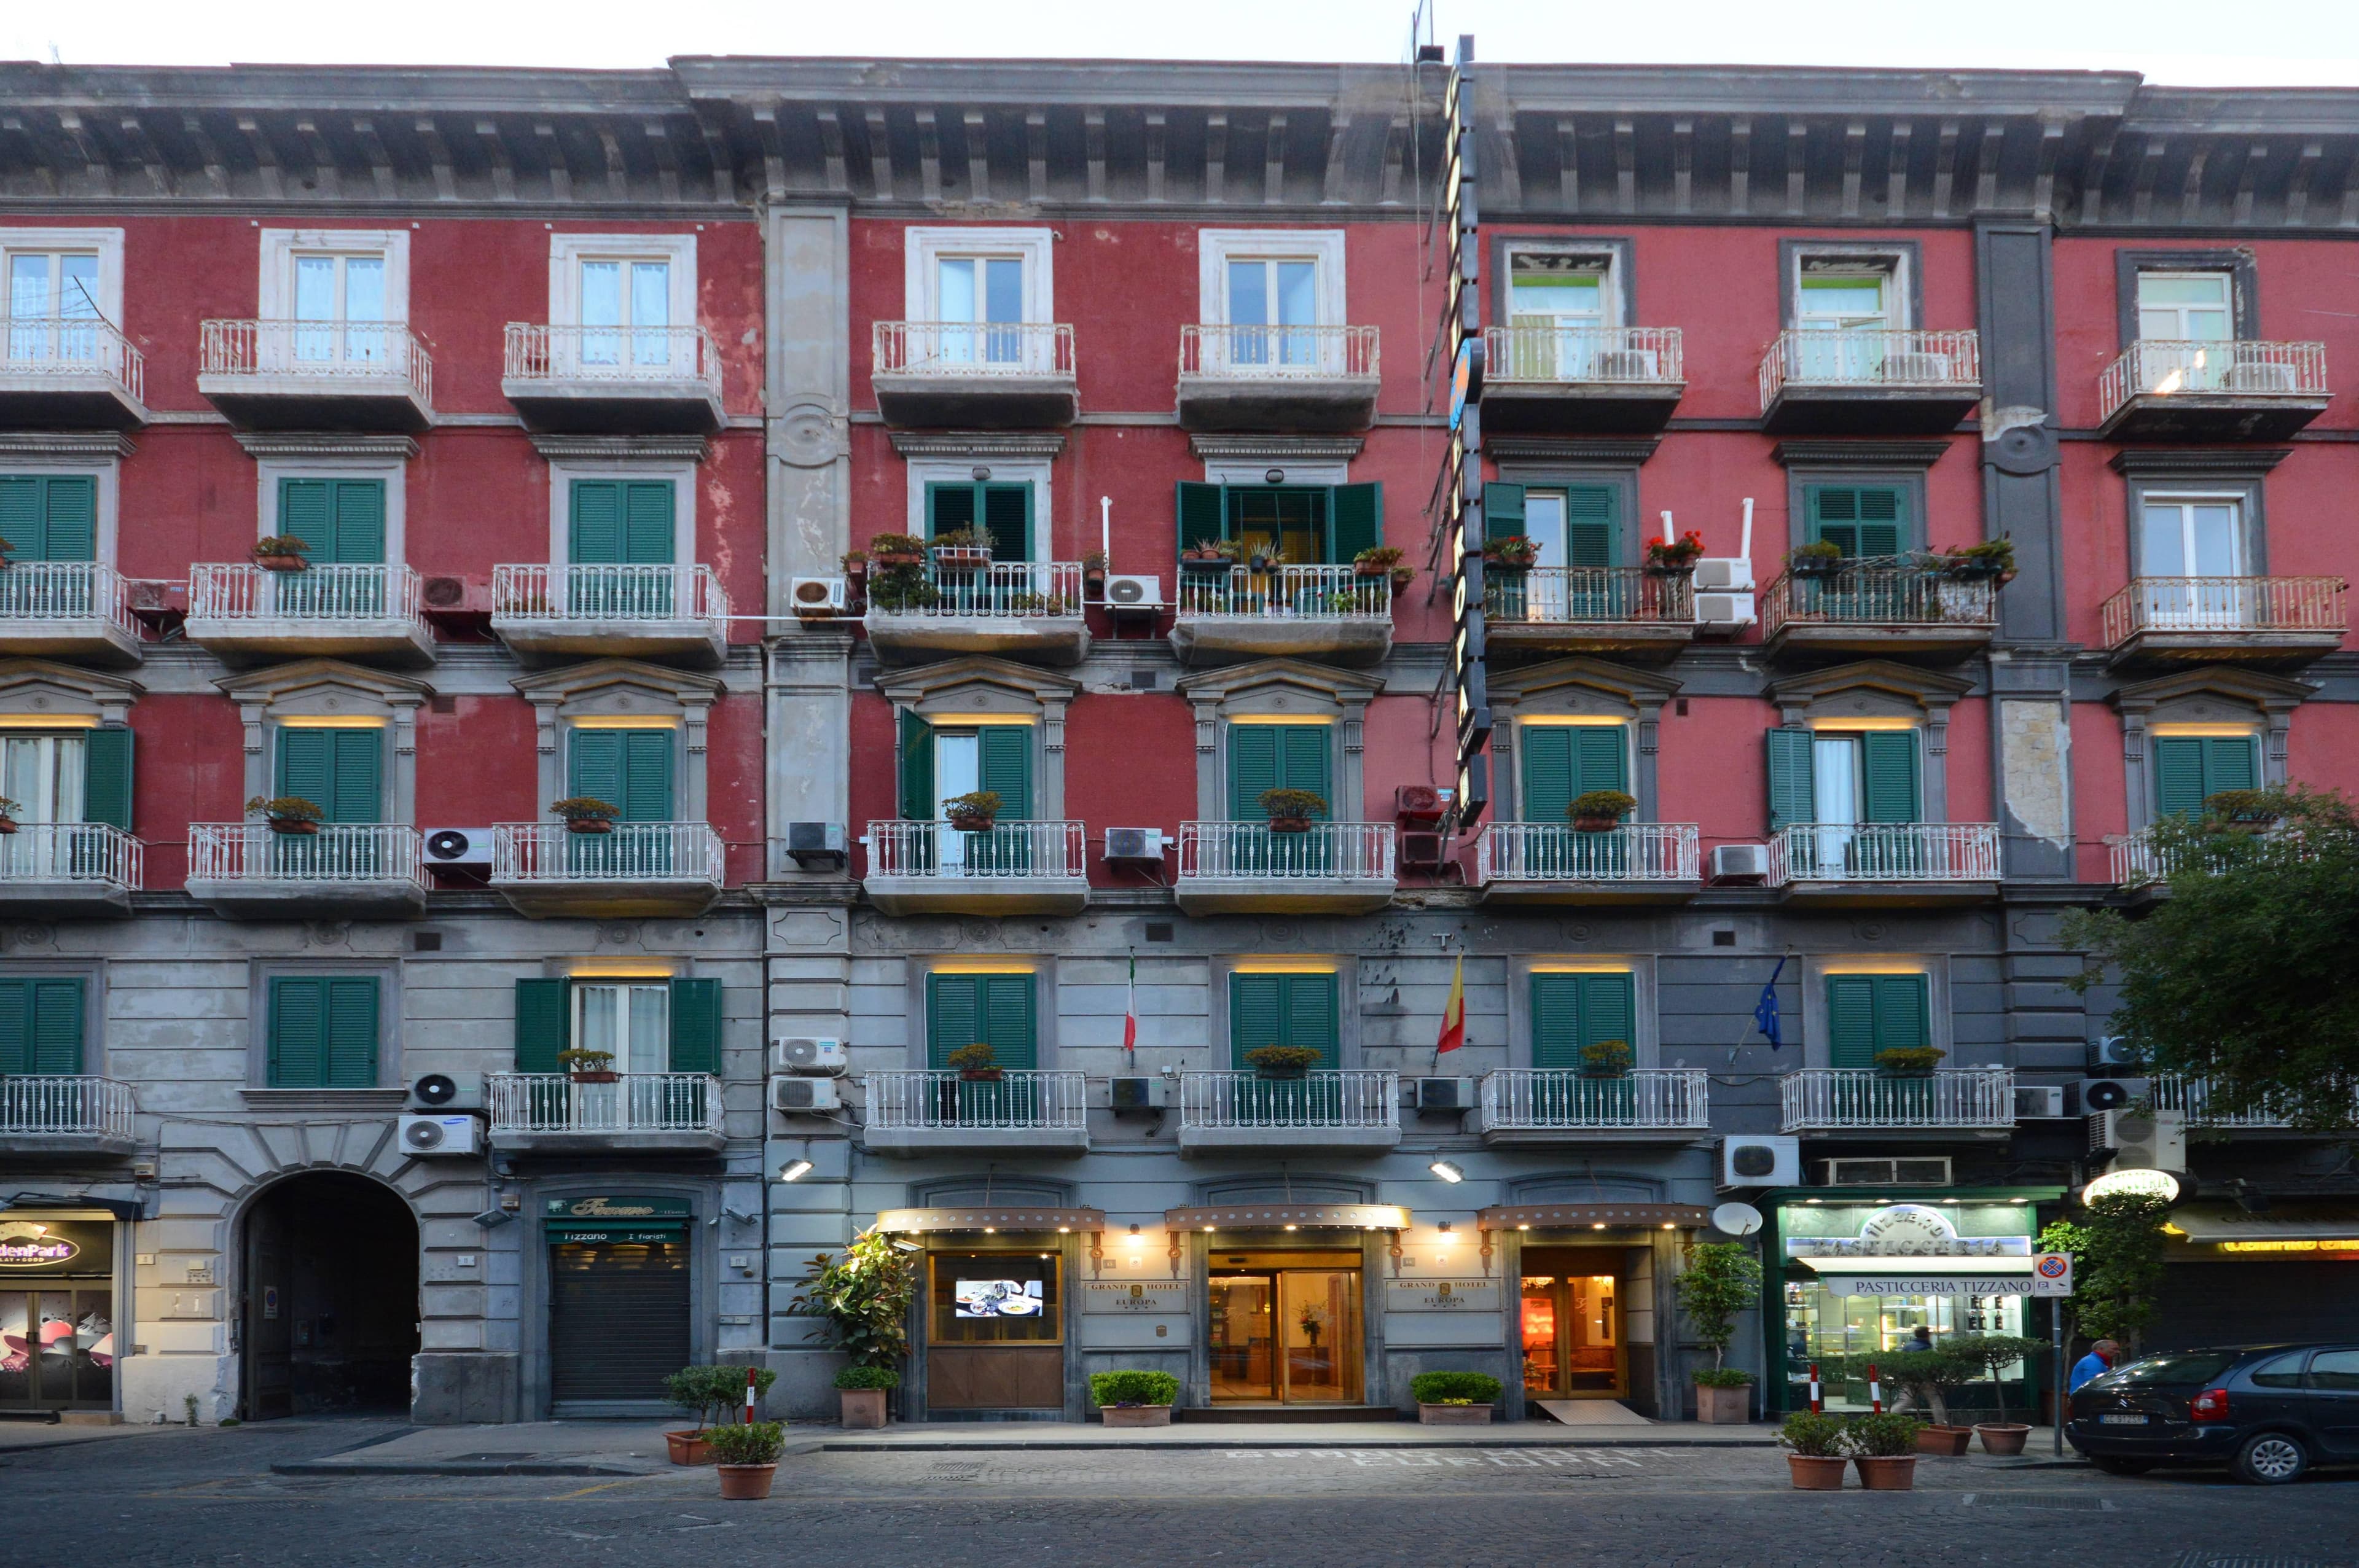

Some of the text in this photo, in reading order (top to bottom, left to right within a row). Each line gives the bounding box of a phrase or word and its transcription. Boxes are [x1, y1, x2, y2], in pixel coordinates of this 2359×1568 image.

[1450, 422, 1469, 728] EUROPA
[1813, 1239, 2005, 1255] PASTICCERIA
[1856, 1281, 2032, 1293] PASTICCERIA TIZZANO
[1352, 1457, 1643, 1467] EUROPA
